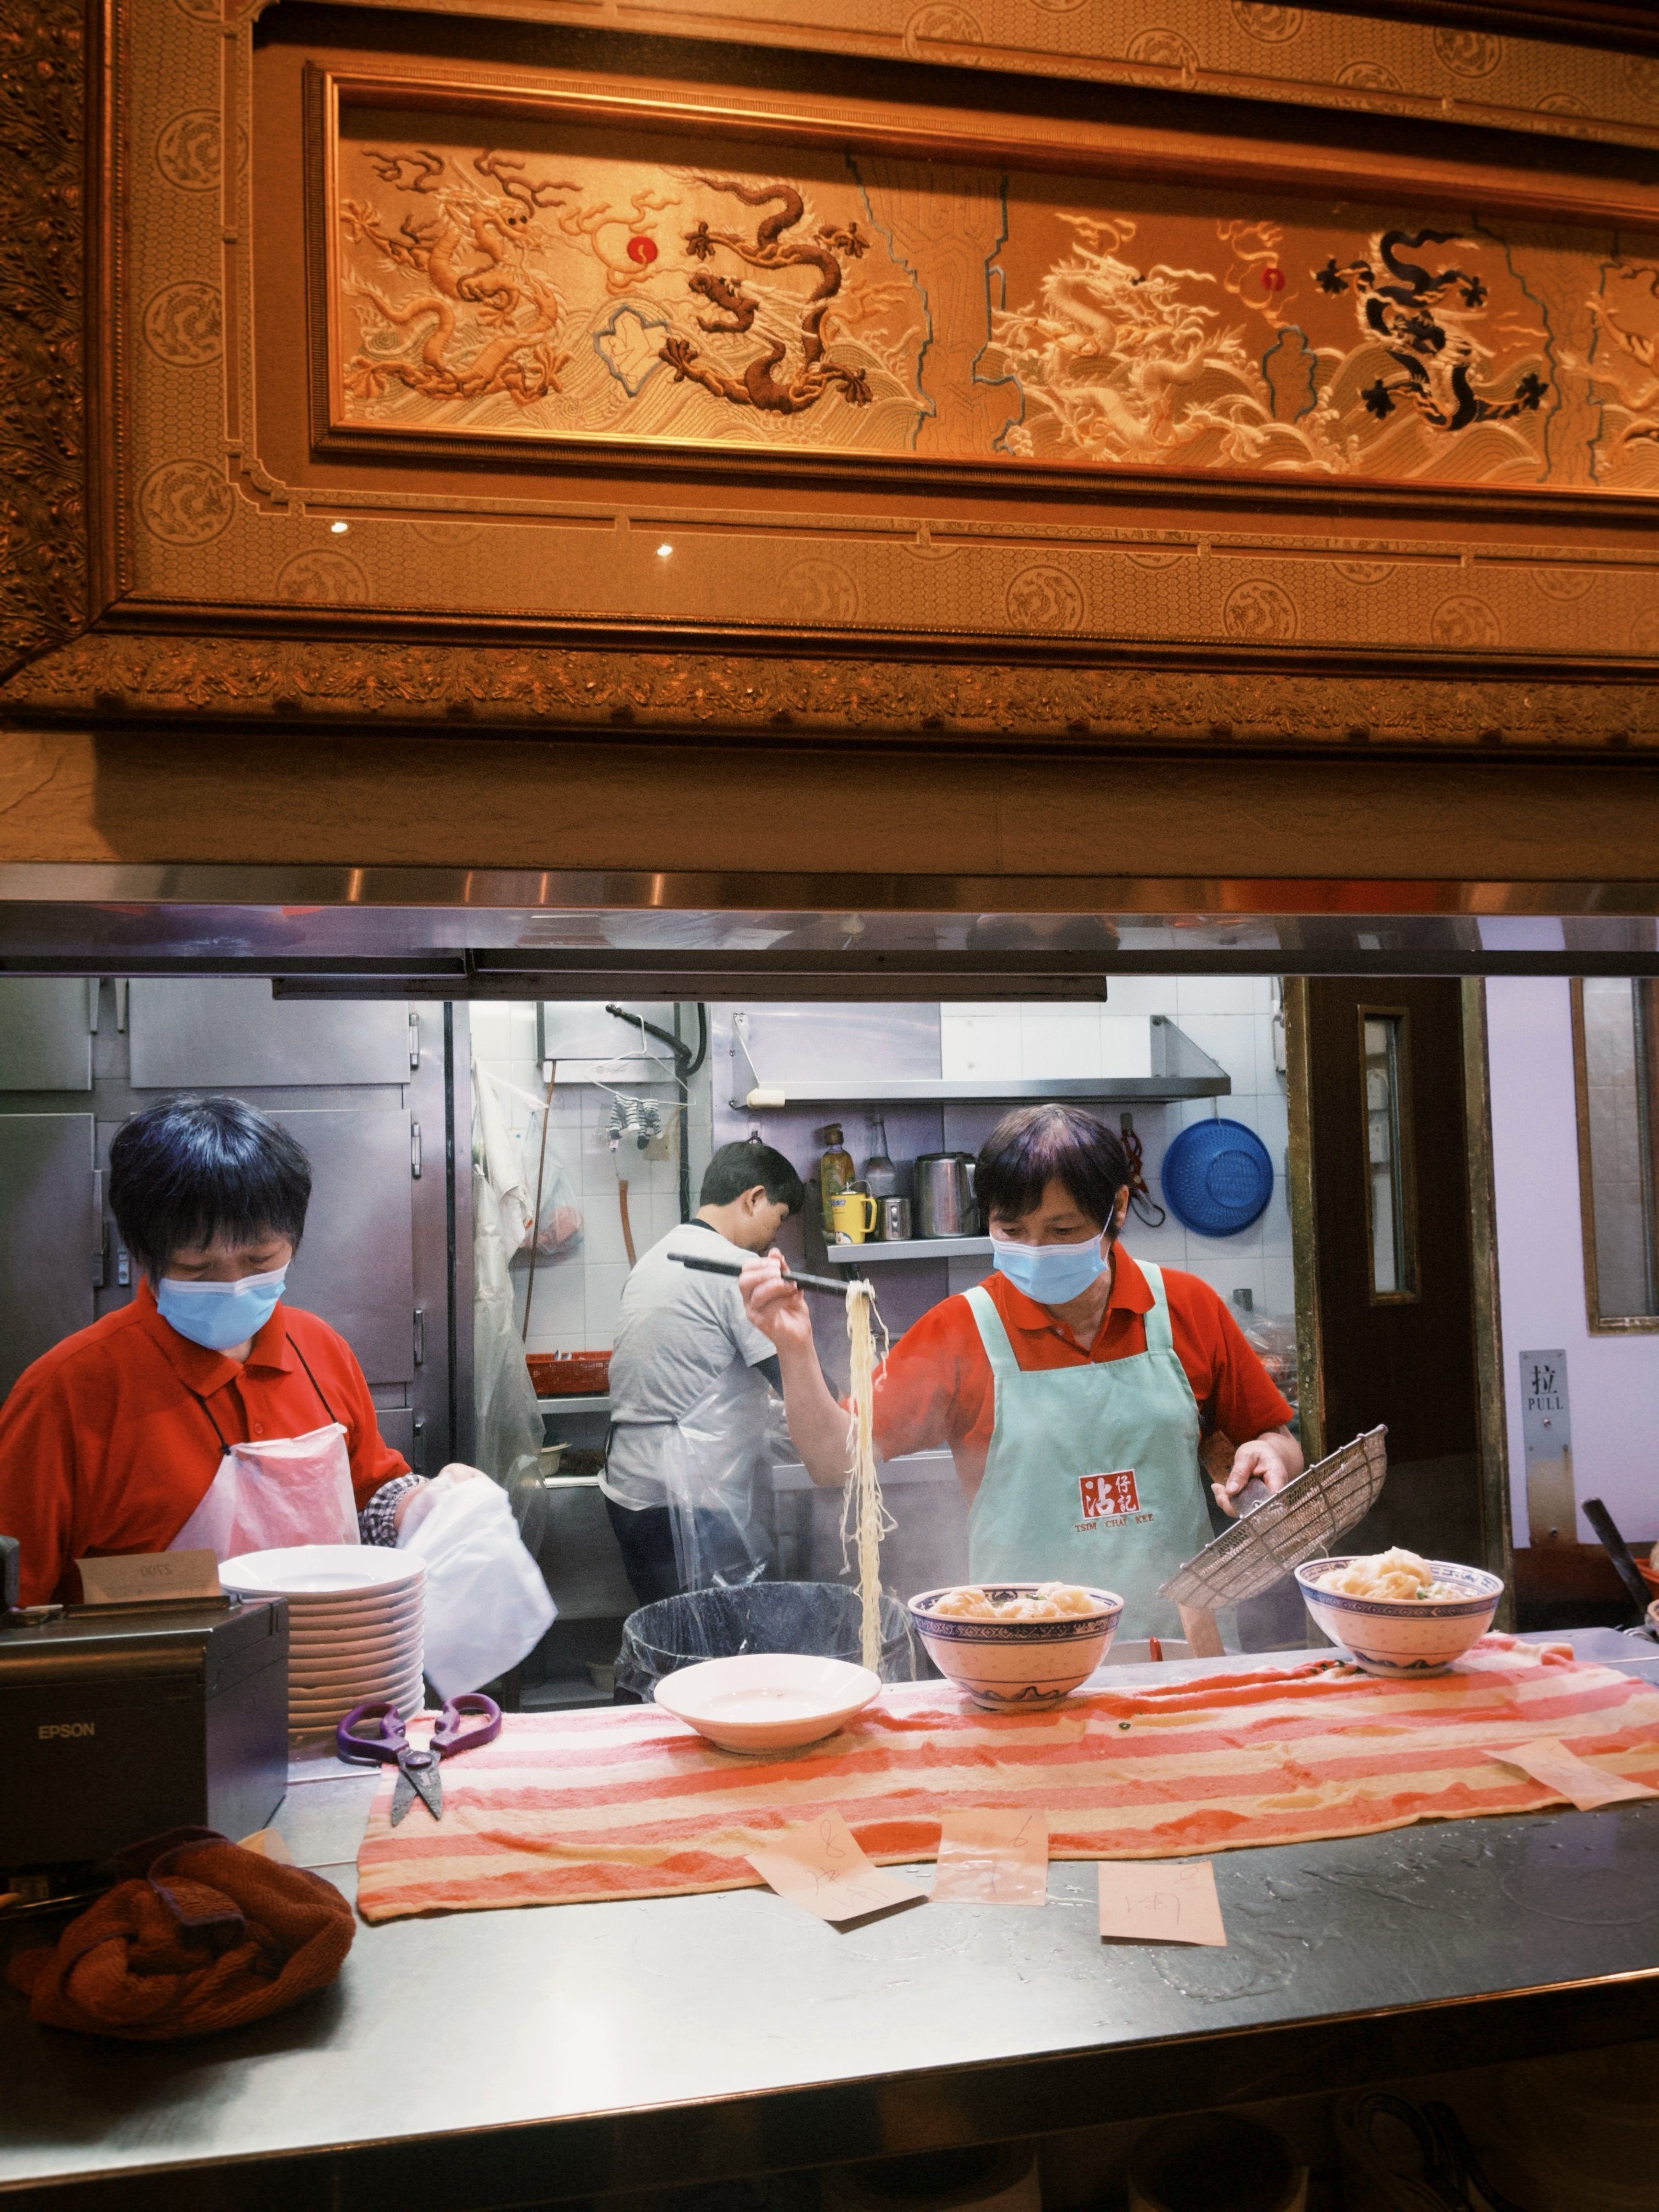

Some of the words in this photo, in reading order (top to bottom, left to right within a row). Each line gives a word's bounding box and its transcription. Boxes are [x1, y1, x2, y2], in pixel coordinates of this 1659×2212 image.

[1531, 1365, 1558, 1395] 拉
[1528, 1397, 1563, 1410] PULL
[1075, 1522, 1097, 1532] TSIM
[1105, 1517, 1127, 1528] CHAI
[1136, 1514, 1154, 1524] KEE
[38, 1722, 95, 1739] EPSON
